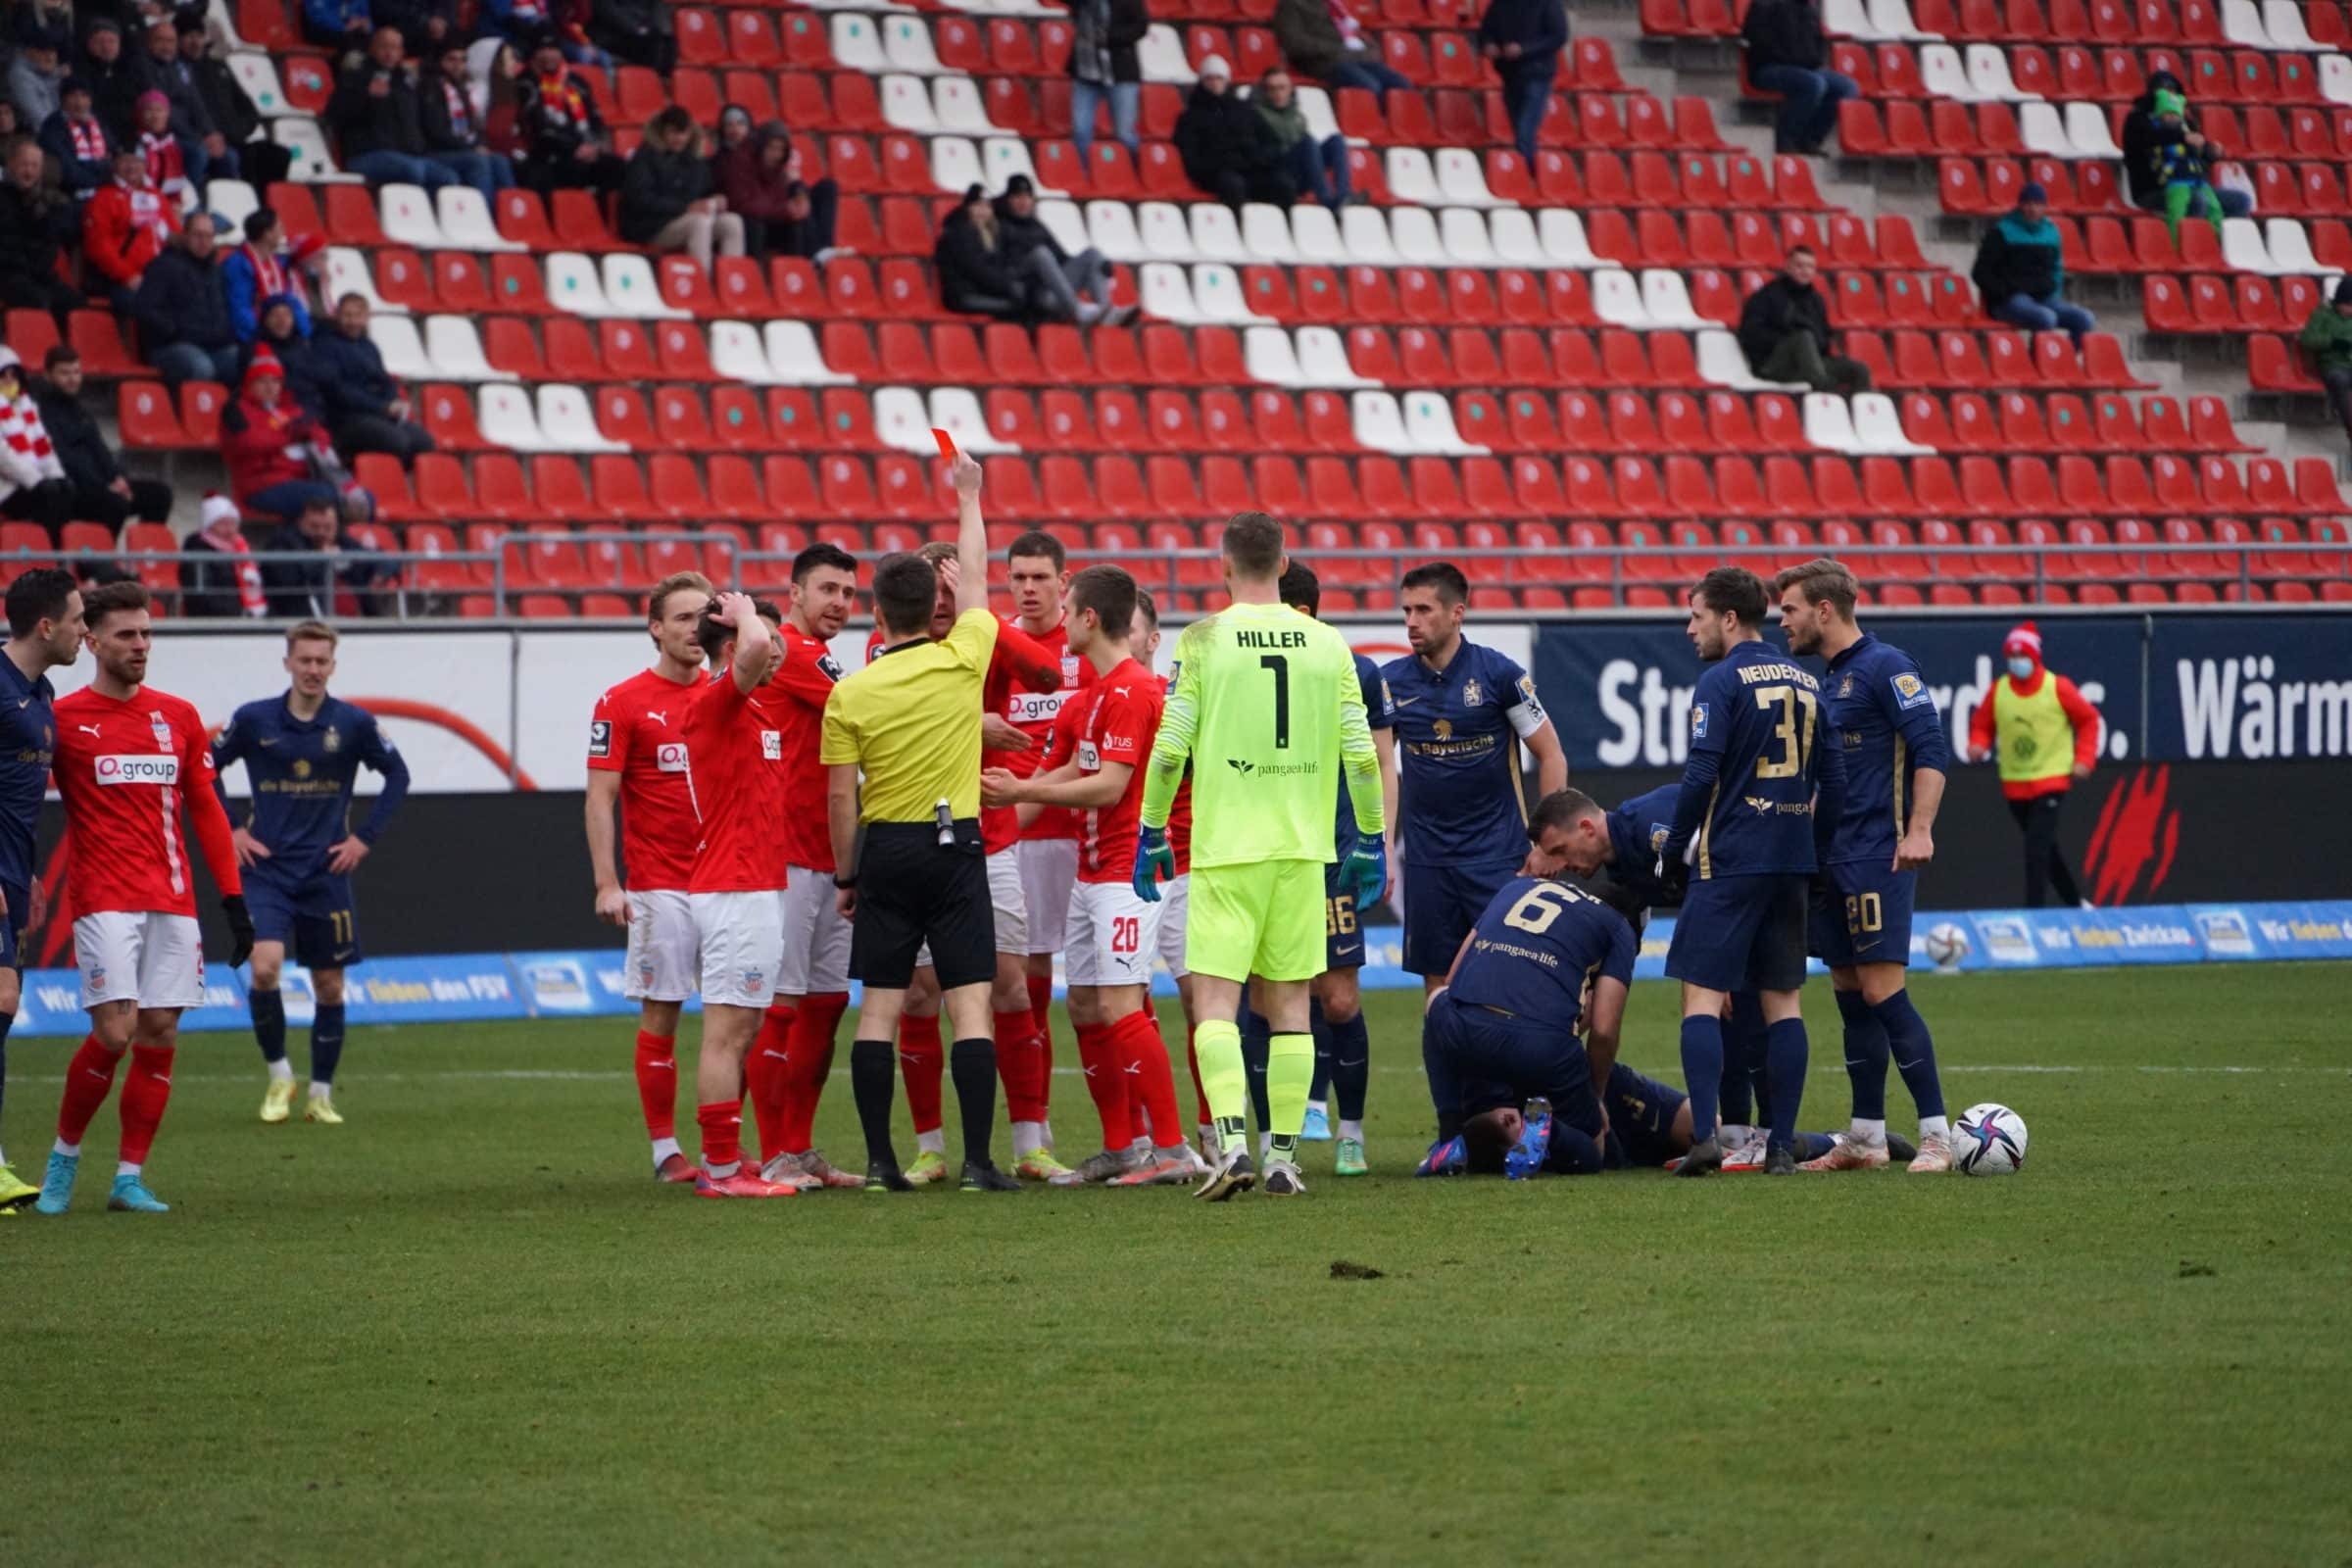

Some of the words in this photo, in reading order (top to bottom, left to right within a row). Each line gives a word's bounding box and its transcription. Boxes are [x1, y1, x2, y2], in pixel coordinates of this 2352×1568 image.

[1237, 630, 1306, 648] HILLER
[1737, 663, 1820, 692] NEUDECKER
[1260, 655, 1289, 749] 1
[1597, 659, 1696, 766] Str
[1755, 685, 1817, 782] 31
[98, 757, 176, 780] O.group
[1503, 883, 1581, 934] 6
[330, 909, 354, 943] 11
[1112, 917, 1139, 952] 20
[2037, 926, 2071, 949] Wir
[2072, 924, 2124, 947] lieben
[2258, 919, 2289, 941] Wir
[2288, 919, 2342, 940] lieben
[36, 986, 78, 1012] Wir
